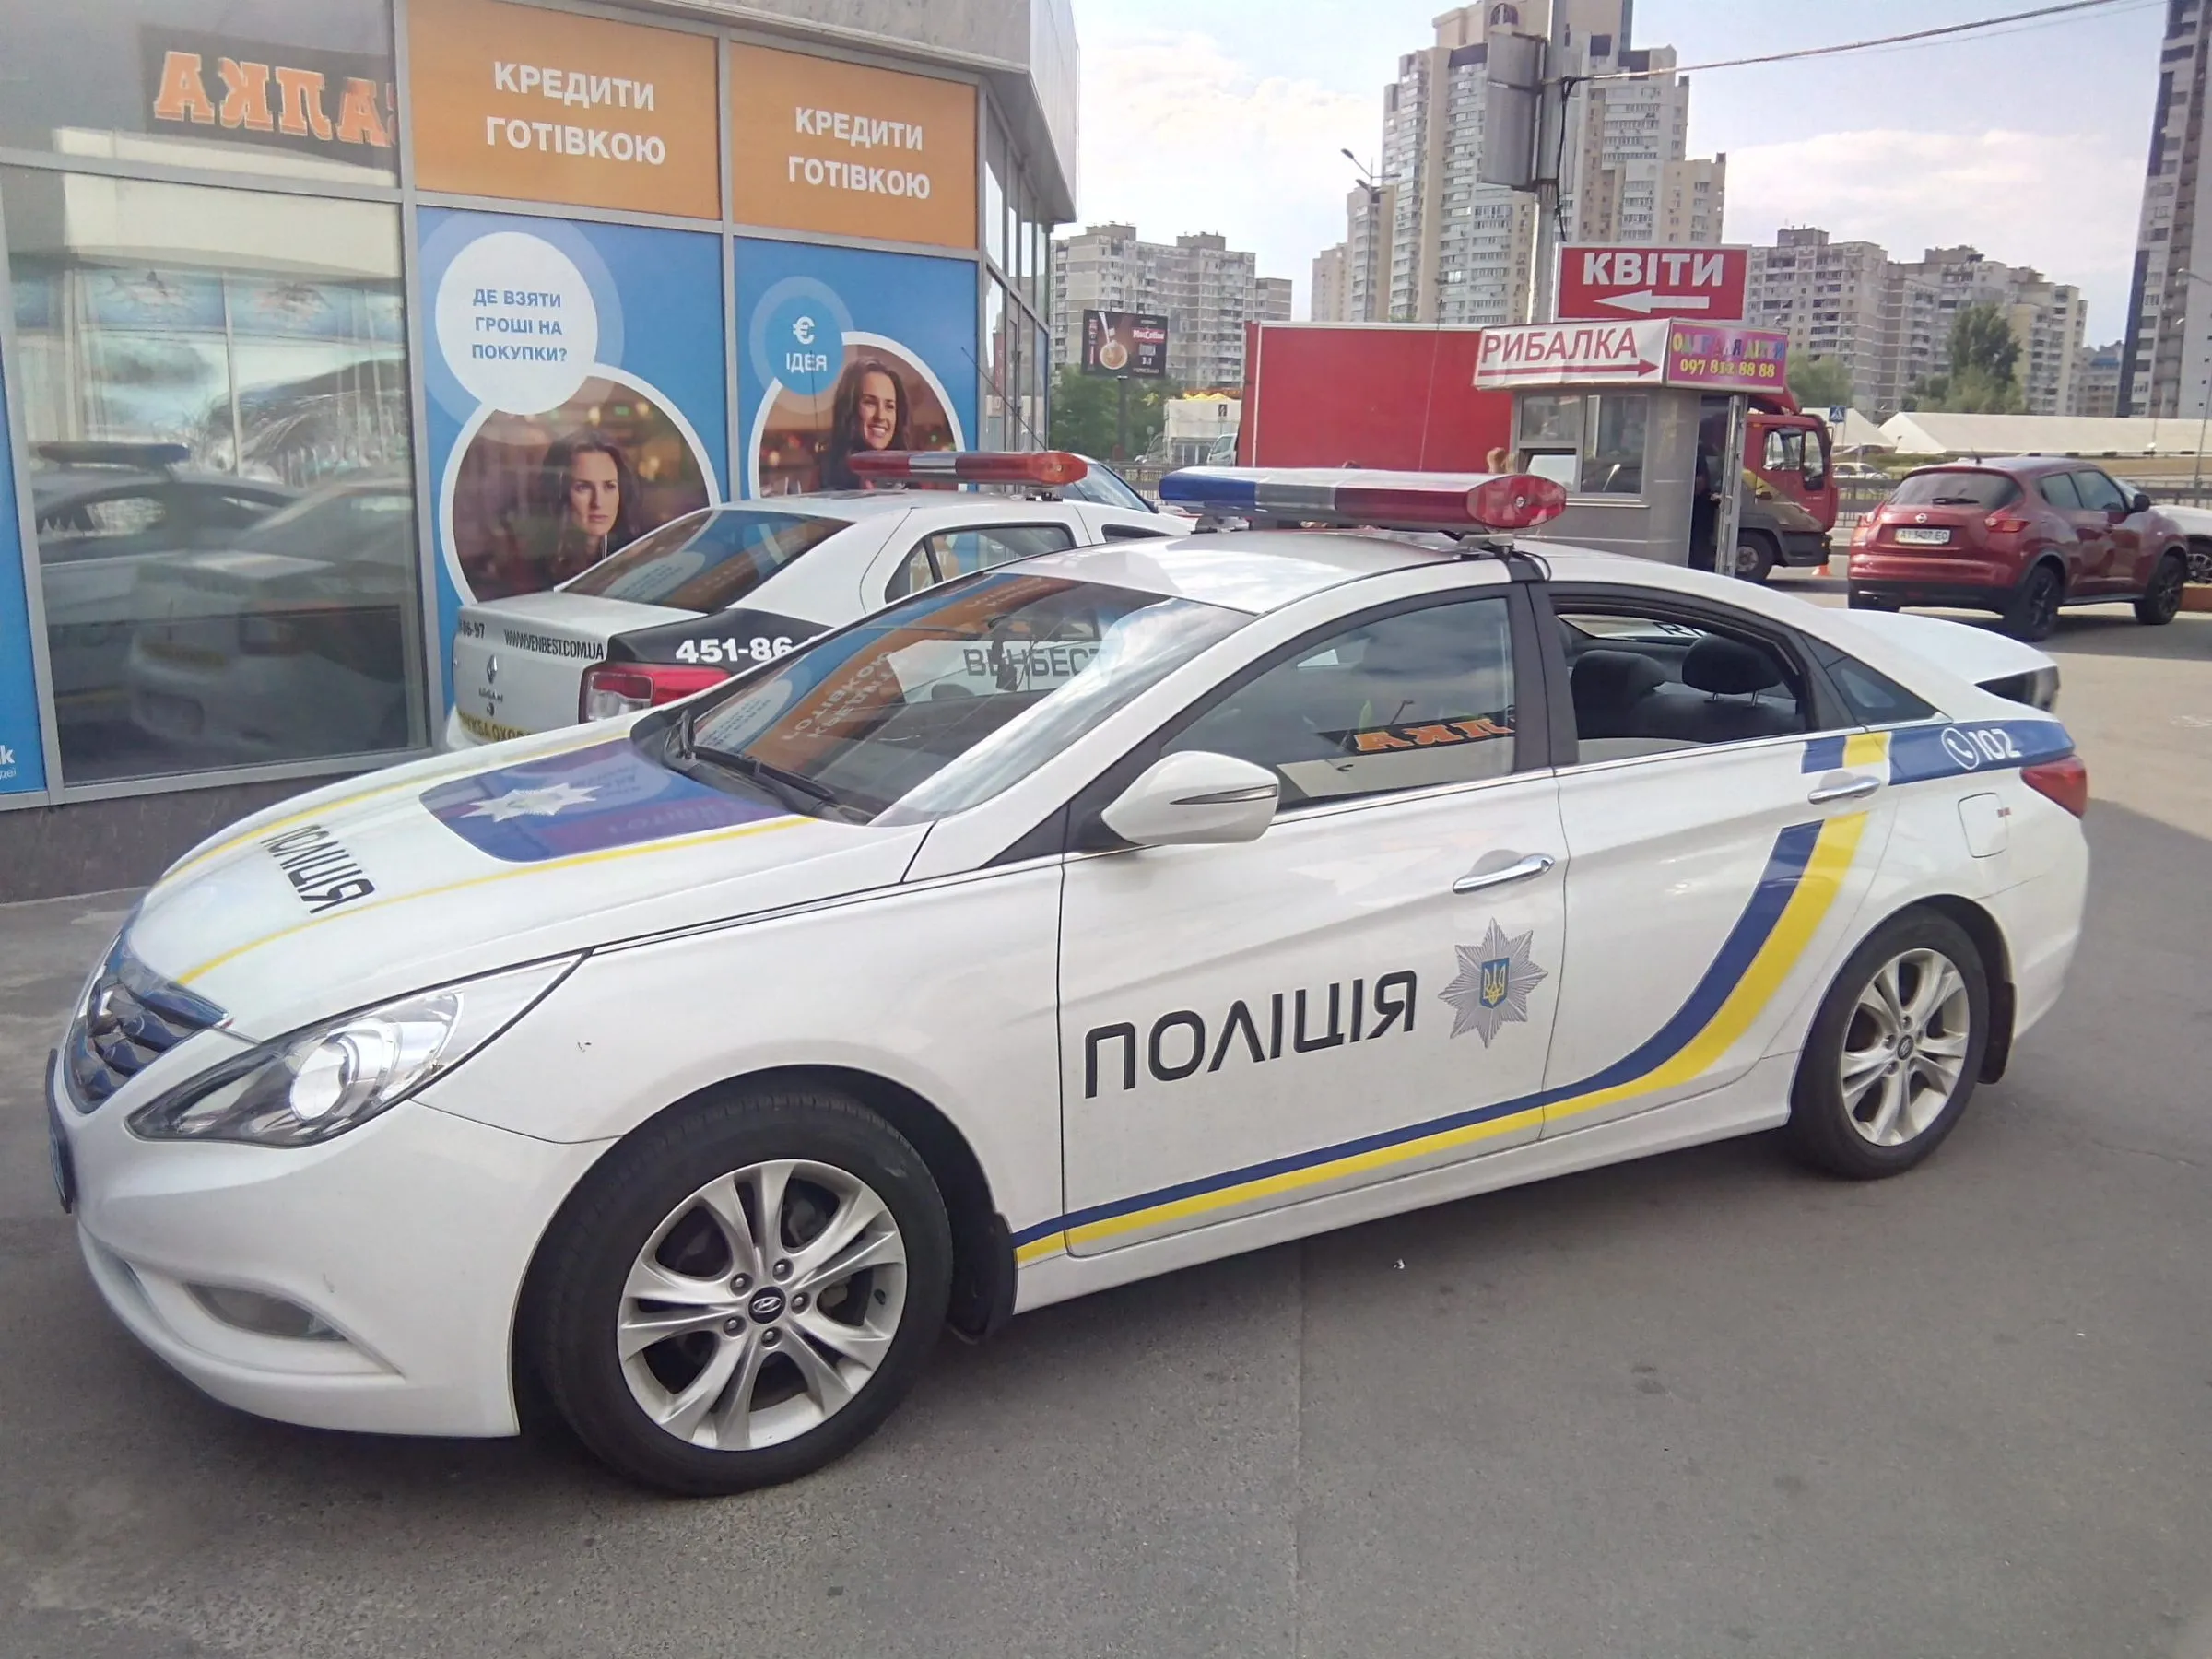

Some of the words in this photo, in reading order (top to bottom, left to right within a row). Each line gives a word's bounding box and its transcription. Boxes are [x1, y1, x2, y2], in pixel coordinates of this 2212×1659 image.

[494, 61, 655, 112] КРЕДИТИ
[486, 115, 666, 166] ГОТІВКОЮ
[795, 106, 923, 151] КРЕДИТИ
[788, 155, 931, 200] ГОТІВКОЮ
[1582, 252, 1724, 287] КВІТИ
[472, 288, 498, 307] ДЕ
[503, 290, 561, 308] ВЗЯТИ
[475, 316, 533, 334] ГРОШІ
[538, 320, 563, 335] НА
[471, 343, 568, 362] ПОКУПКИ?
[1482, 326, 1639, 364] РИБАЛКА
[786, 352, 828, 374] ІДЕЯ
[1680, 358, 1707, 376] 097
[1738, 361, 1756, 377] 88
[1758, 363, 1776, 378] 88
[675, 636, 818, 664] 451-86
[1968, 728, 2023, 760] 102
[260, 824, 375, 914] ПОЛІЦІЯ
[1085, 970, 1418, 1100] ПОЛІЦІЯ
